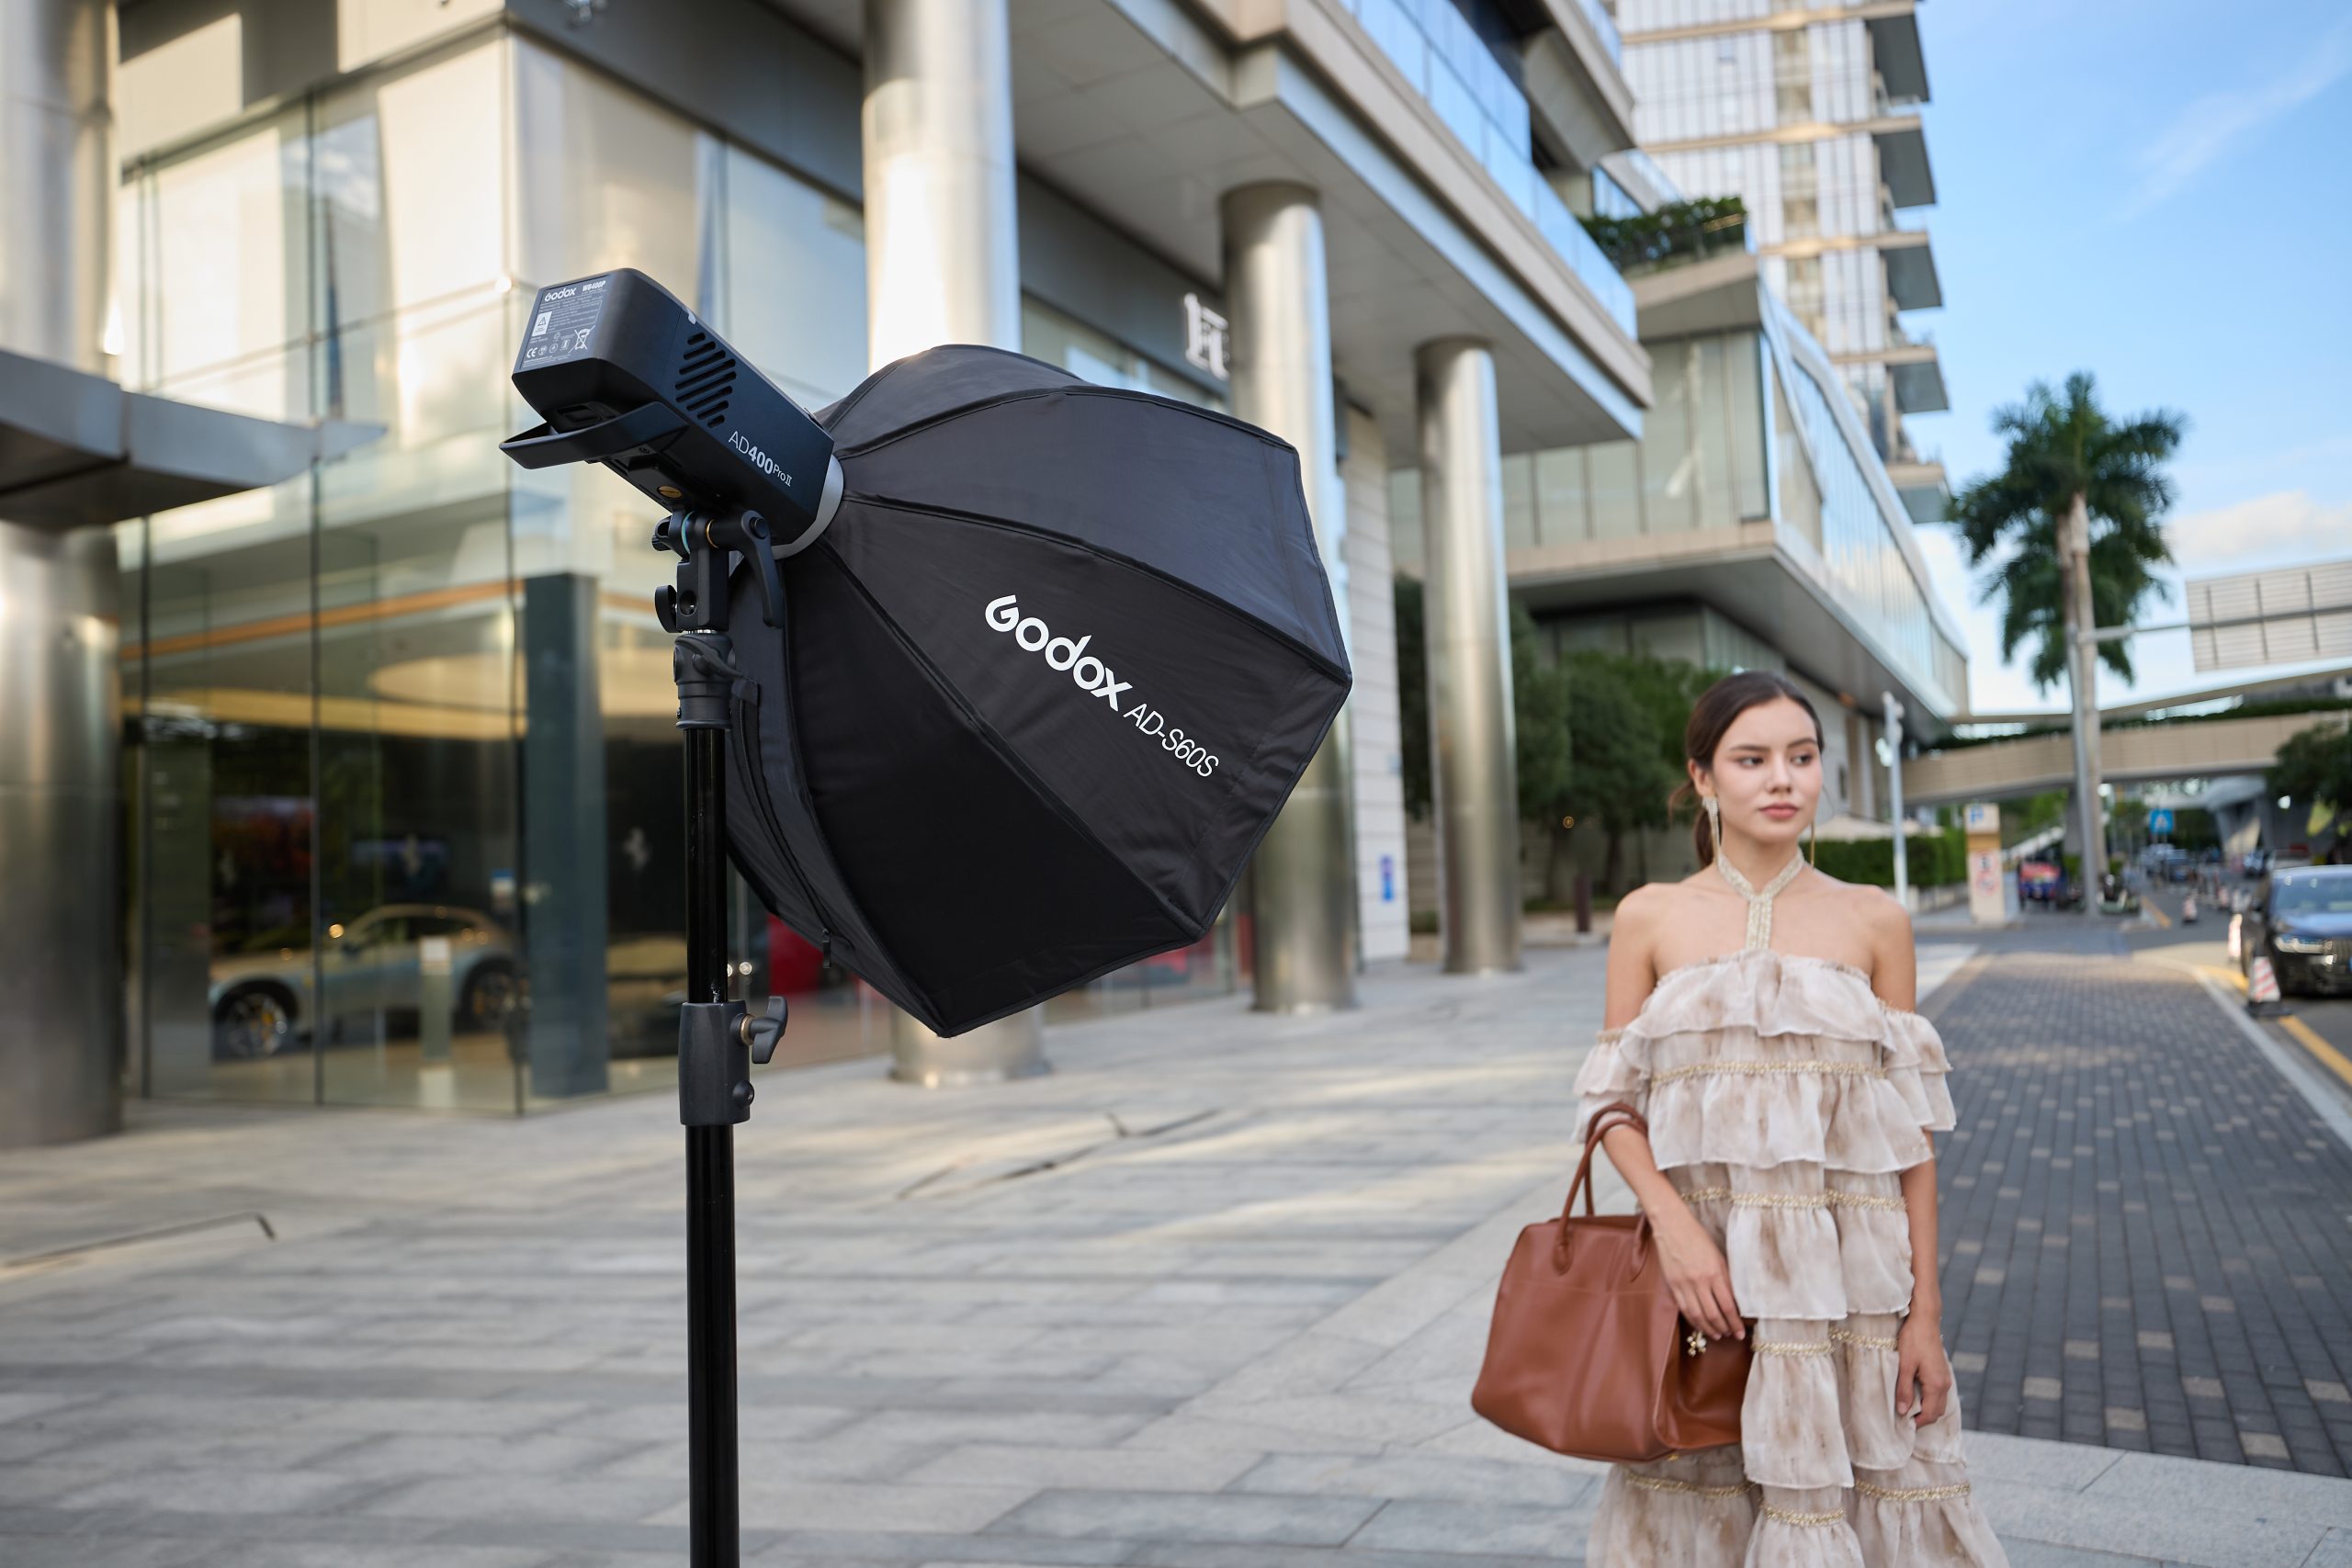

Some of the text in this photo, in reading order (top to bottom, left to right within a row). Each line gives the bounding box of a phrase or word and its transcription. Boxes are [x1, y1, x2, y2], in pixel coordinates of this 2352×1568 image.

[545, 280, 606, 302] Godox WB400P
[526, 346, 538, 358] CE
[985, 594, 1219, 777] Godox AD-S60S
